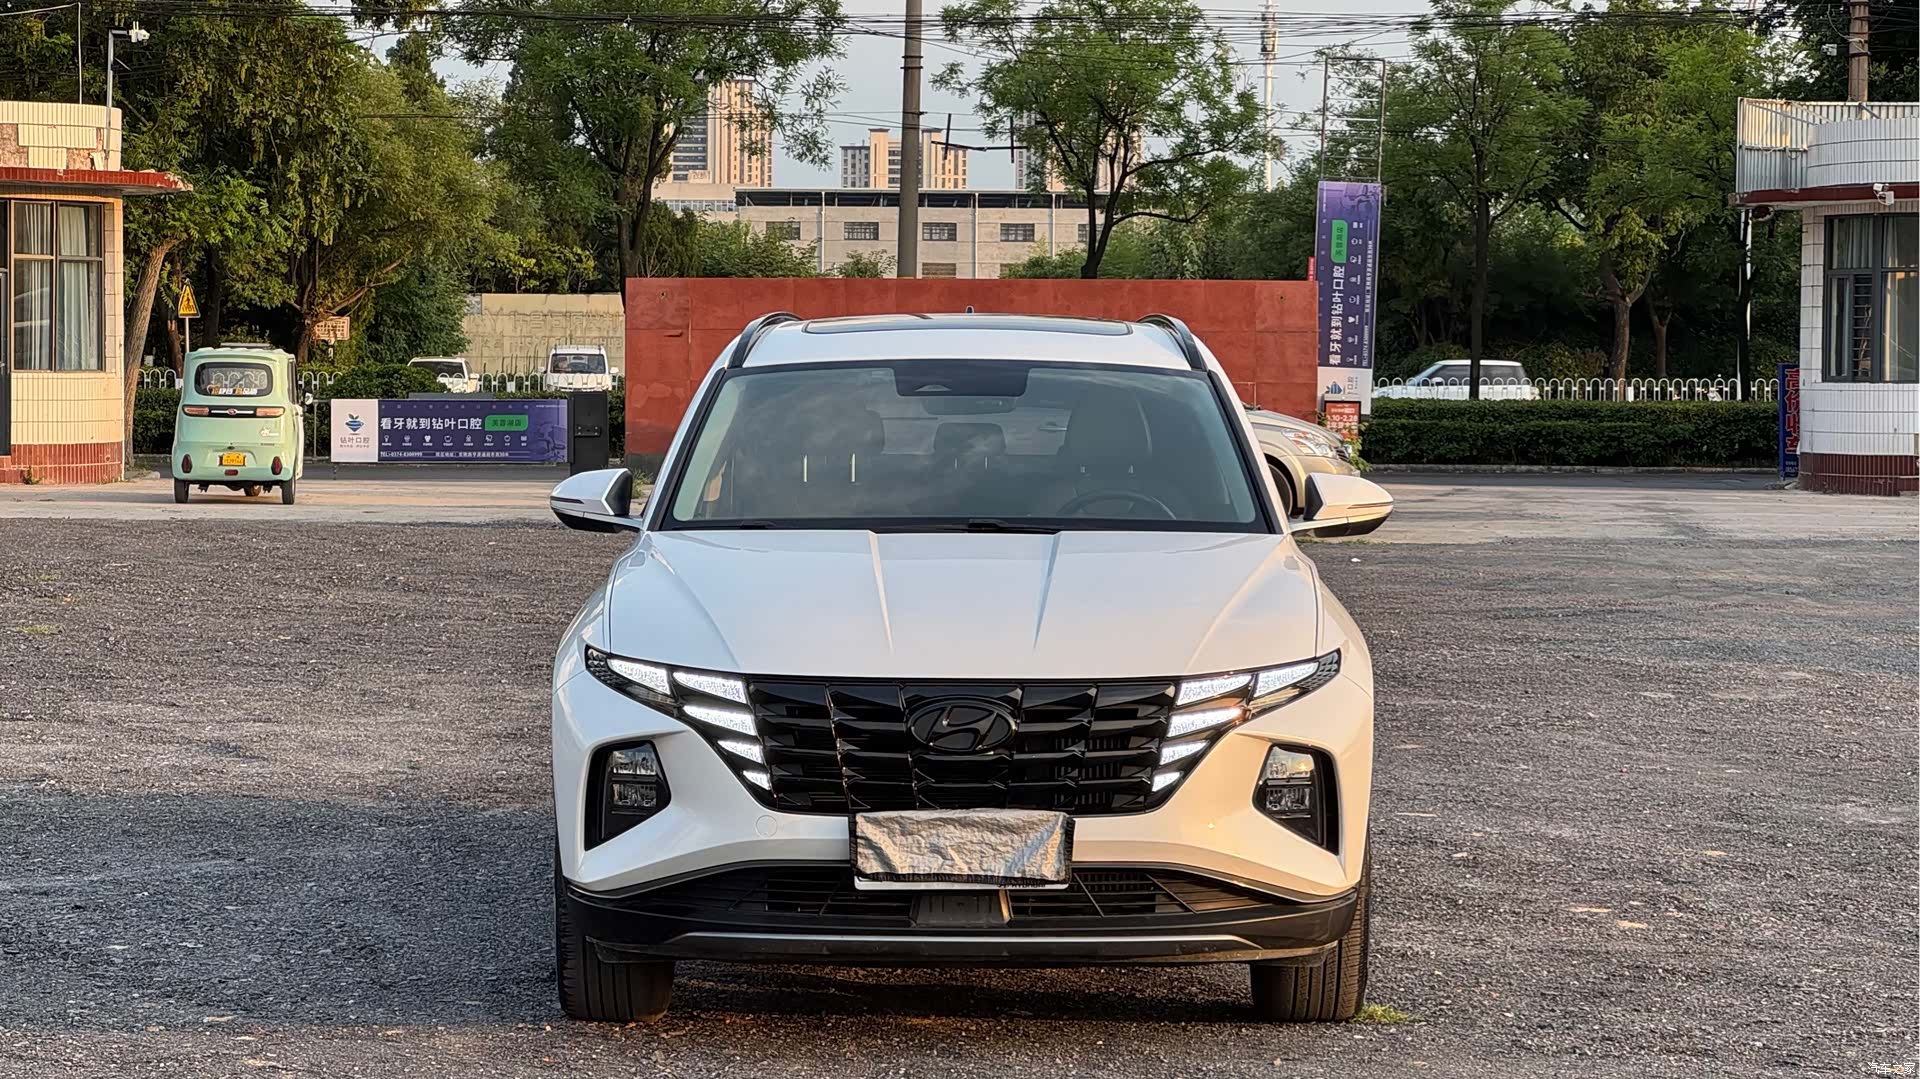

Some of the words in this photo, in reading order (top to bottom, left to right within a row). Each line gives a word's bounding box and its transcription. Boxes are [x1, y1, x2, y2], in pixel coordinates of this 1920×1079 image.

[1329, 265, 1345, 366] 看牙就到钻叶口腔
[380, 417, 482, 430] 看牙就到钻叶口腔
[340, 436, 370, 444] 钻叶口腔
